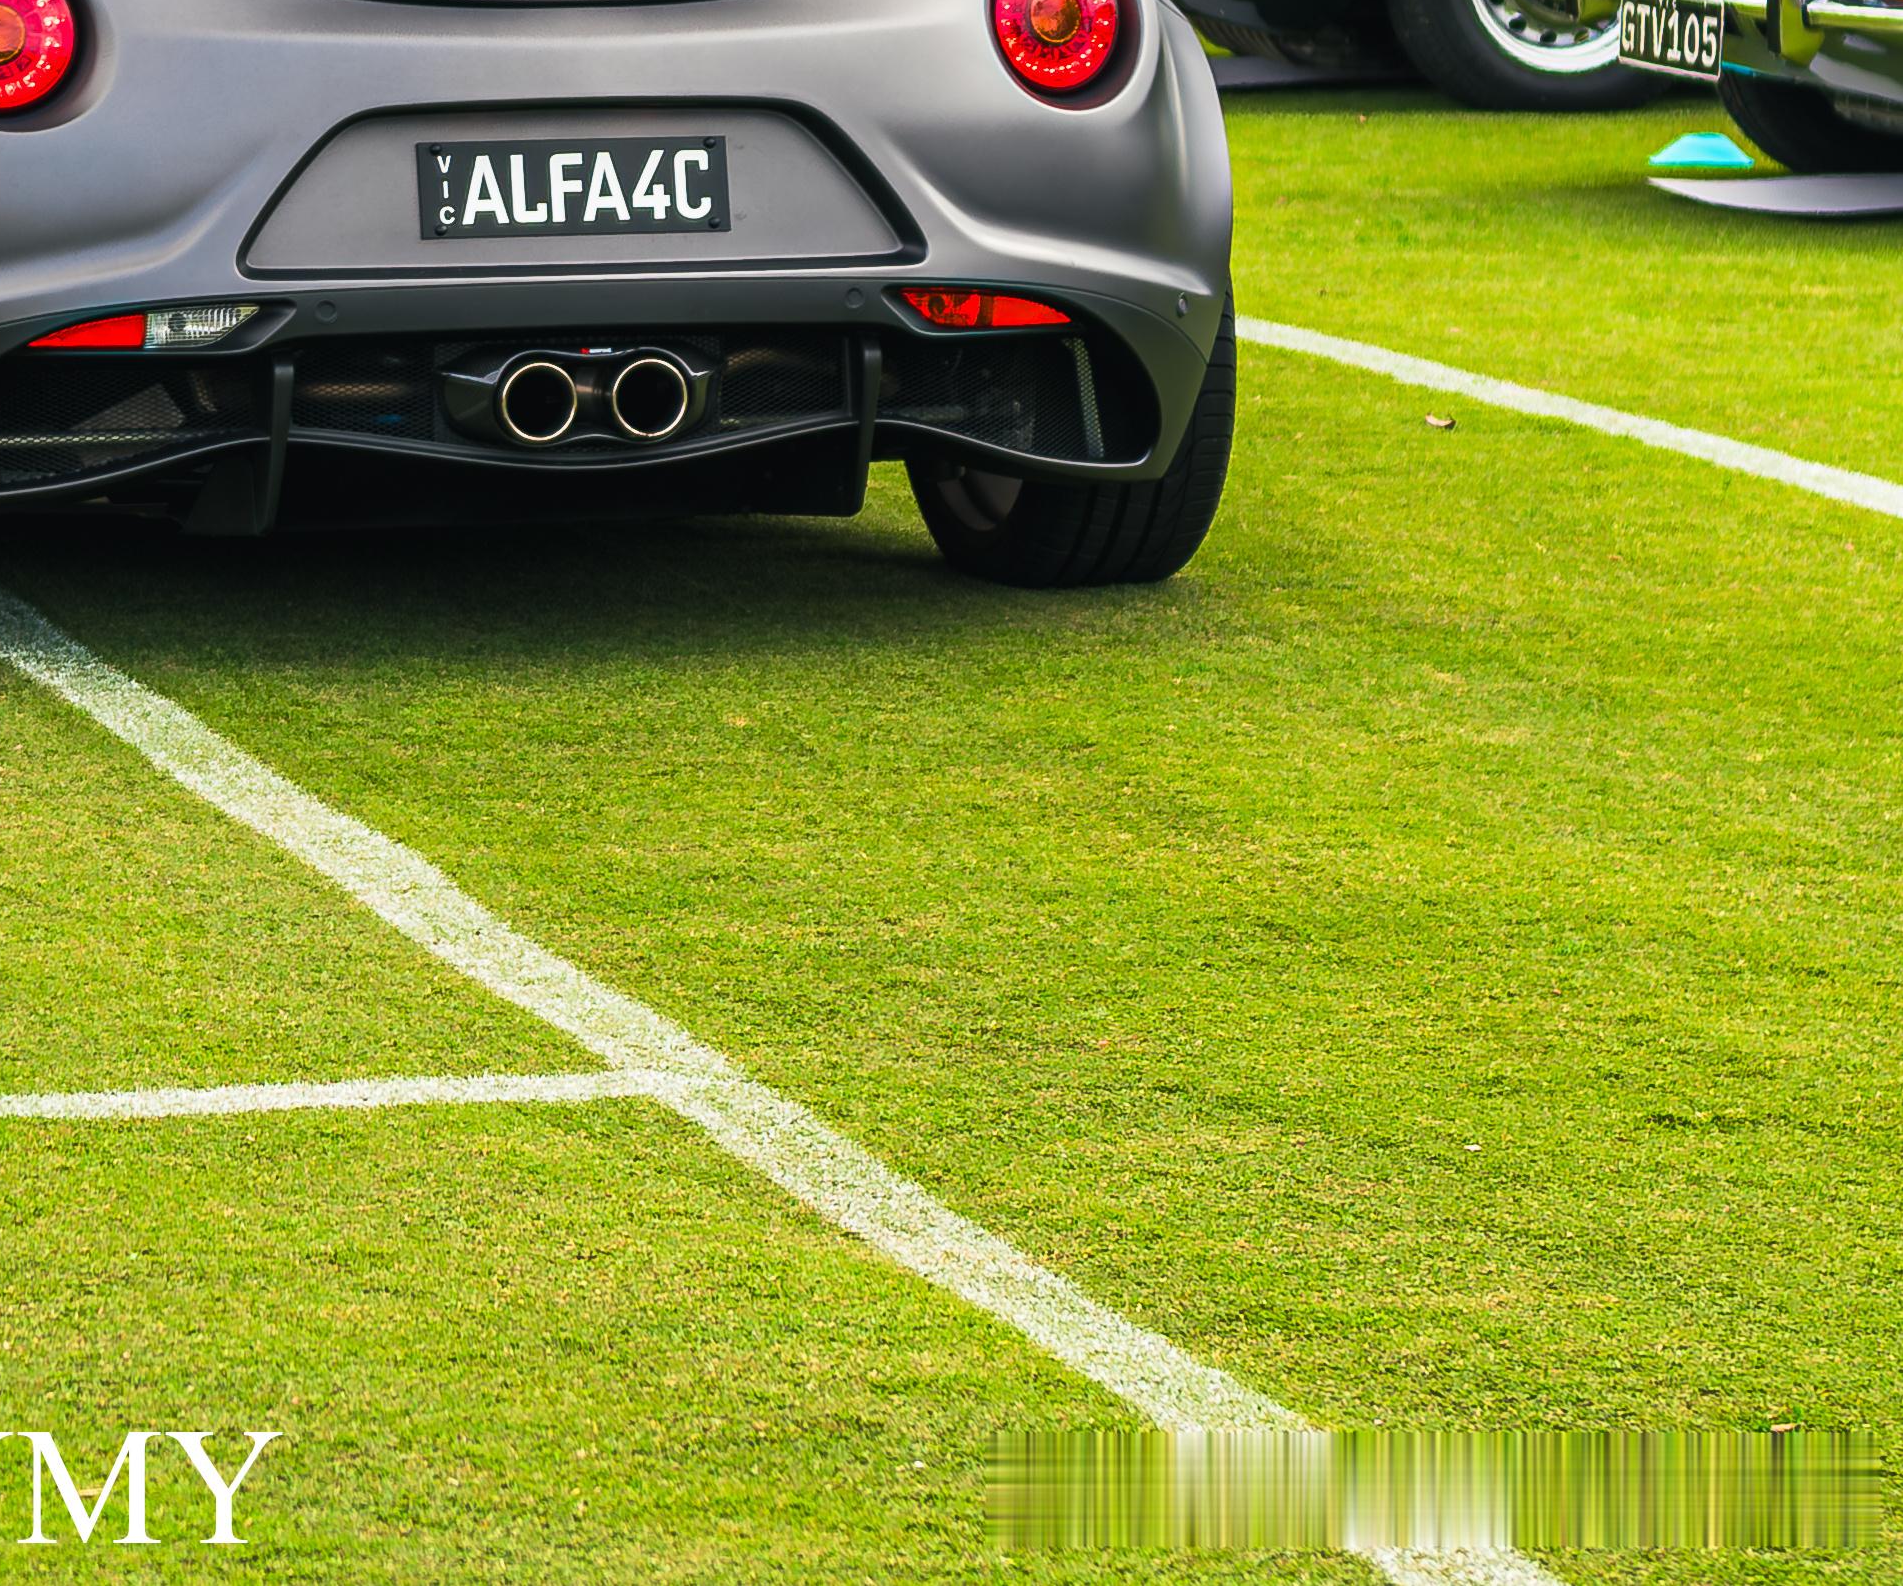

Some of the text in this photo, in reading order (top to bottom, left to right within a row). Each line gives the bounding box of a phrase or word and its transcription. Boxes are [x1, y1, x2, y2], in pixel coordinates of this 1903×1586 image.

[1621, 1, 1718, 67] GTV105
[437, 155, 456, 225] VIC
[461, 149, 712, 225] ALFA4C
